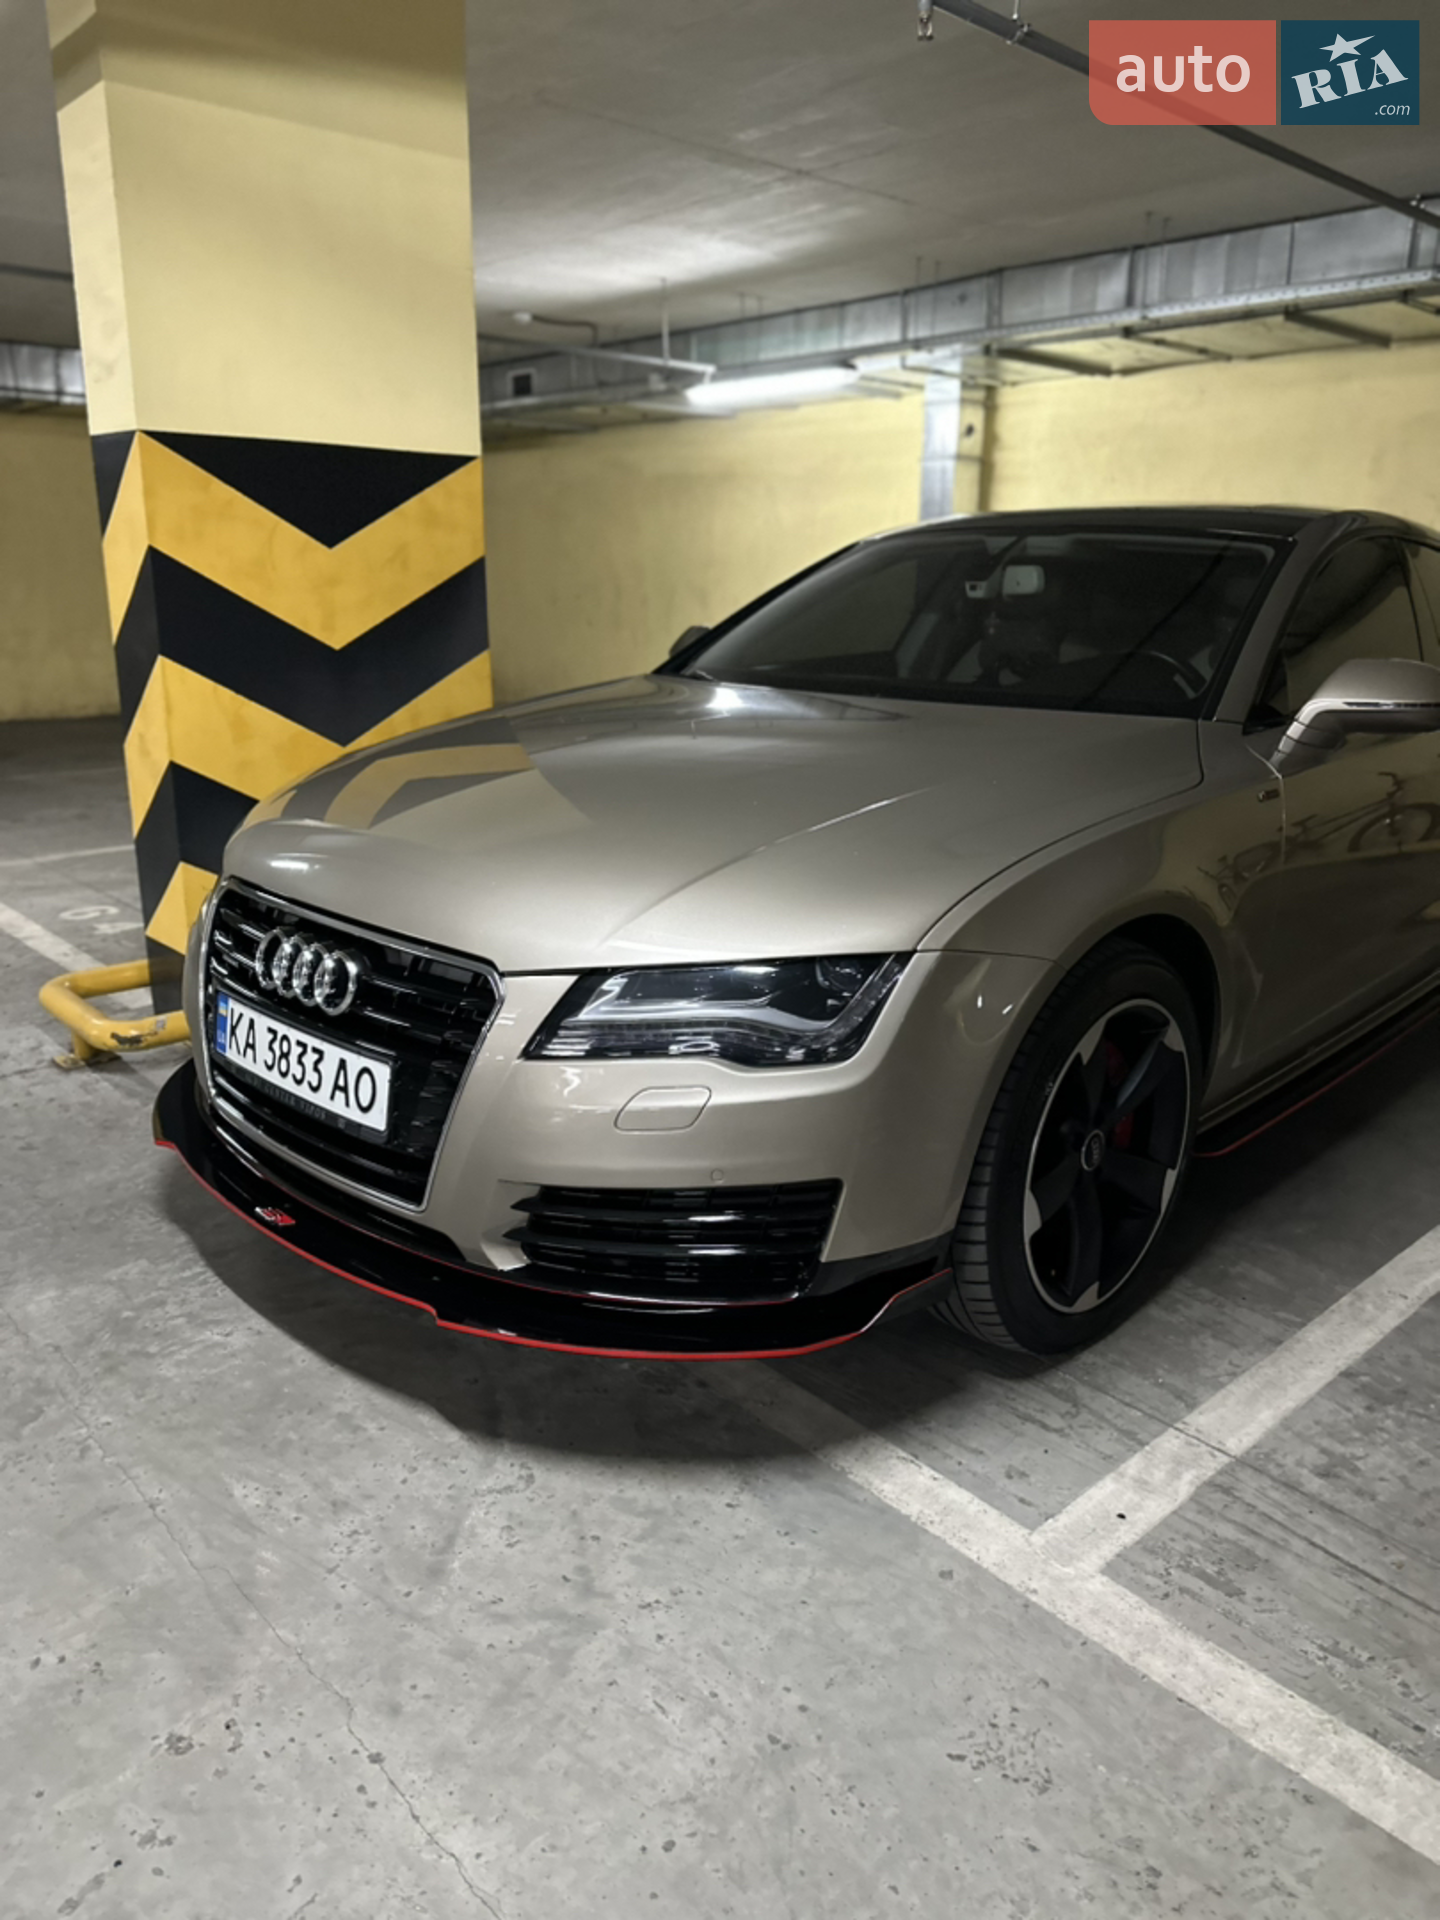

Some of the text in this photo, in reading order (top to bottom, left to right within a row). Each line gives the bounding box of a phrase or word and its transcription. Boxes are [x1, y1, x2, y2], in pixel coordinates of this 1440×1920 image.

[229, 1007, 377, 1114] KA 3833 AO
